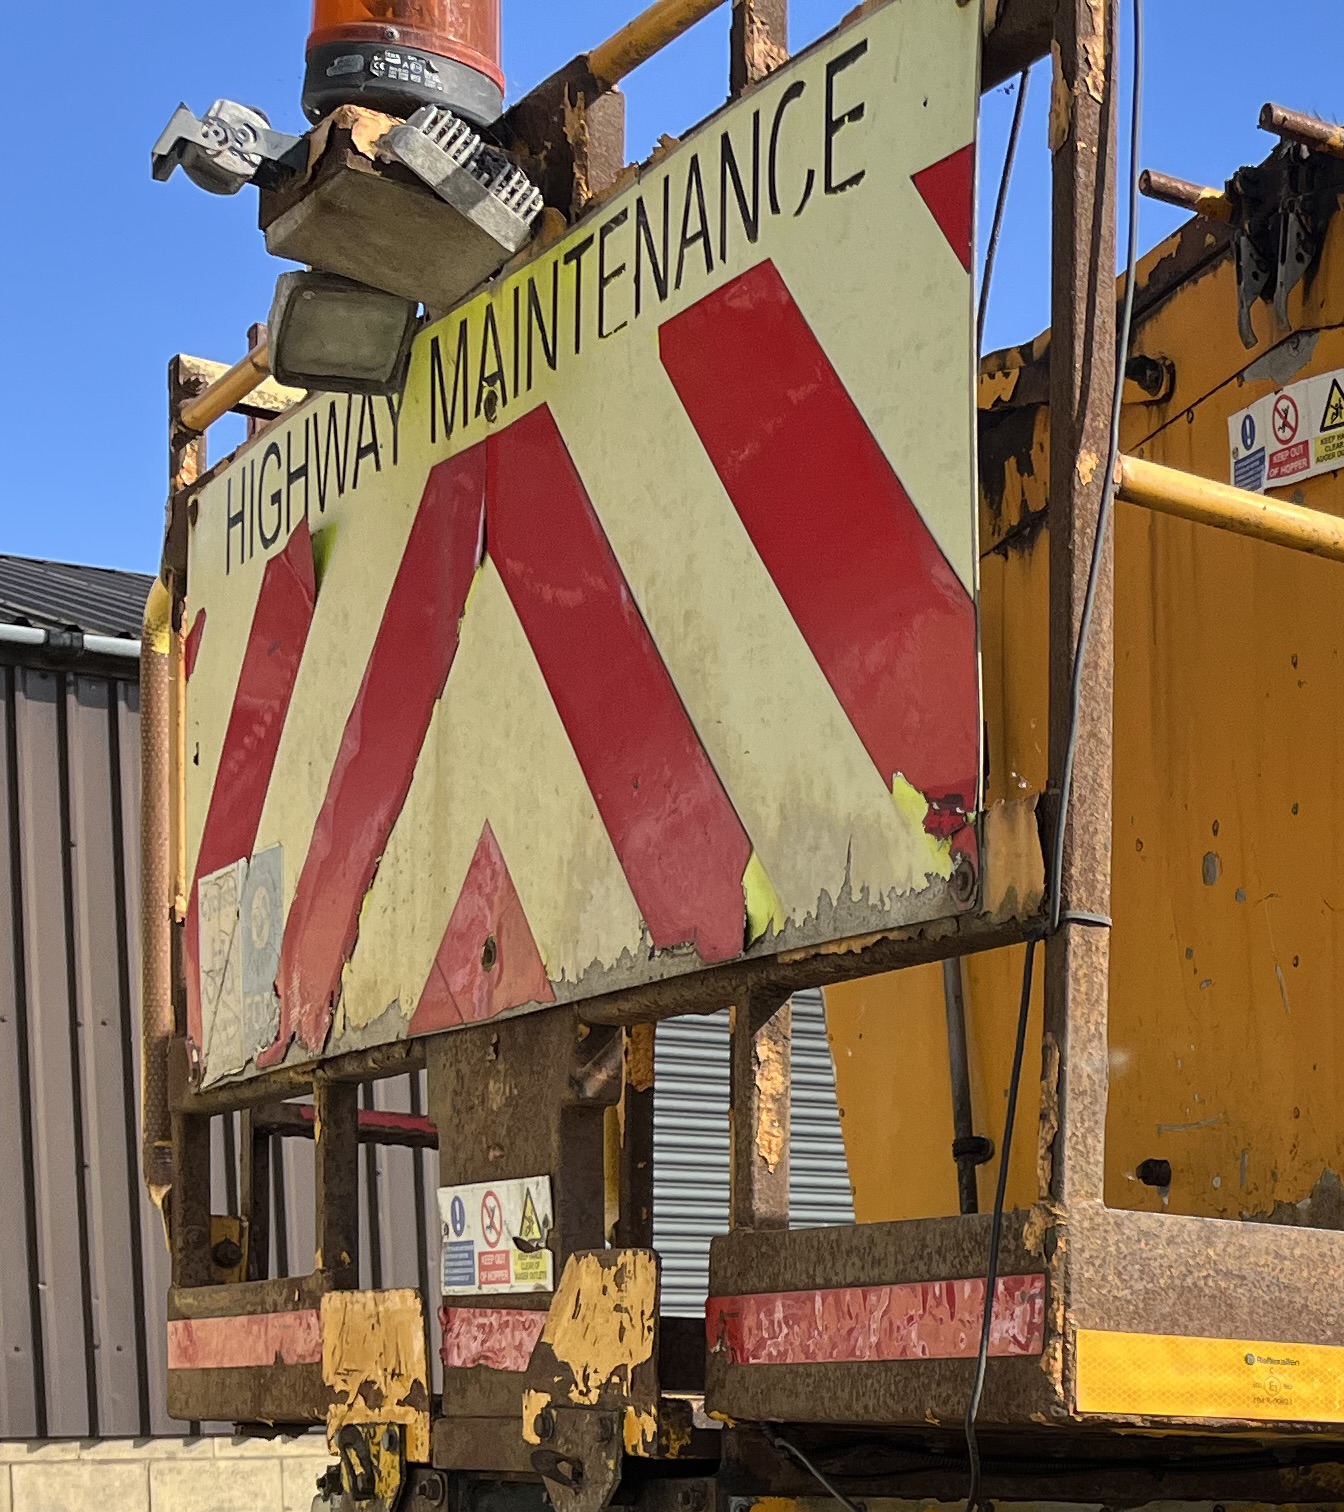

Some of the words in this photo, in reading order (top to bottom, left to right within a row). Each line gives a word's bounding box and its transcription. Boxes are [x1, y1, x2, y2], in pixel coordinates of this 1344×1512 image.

[226, 393, 401, 576] HIGHWAY
[428, 39, 870, 444] MAINTENANCE
[1272, 450, 1290, 464] KEEP
[1290, 444, 1304, 458] OUT
[1269, 467, 1280, 478] OF
[1280, 458, 1308, 476] HOPPER
